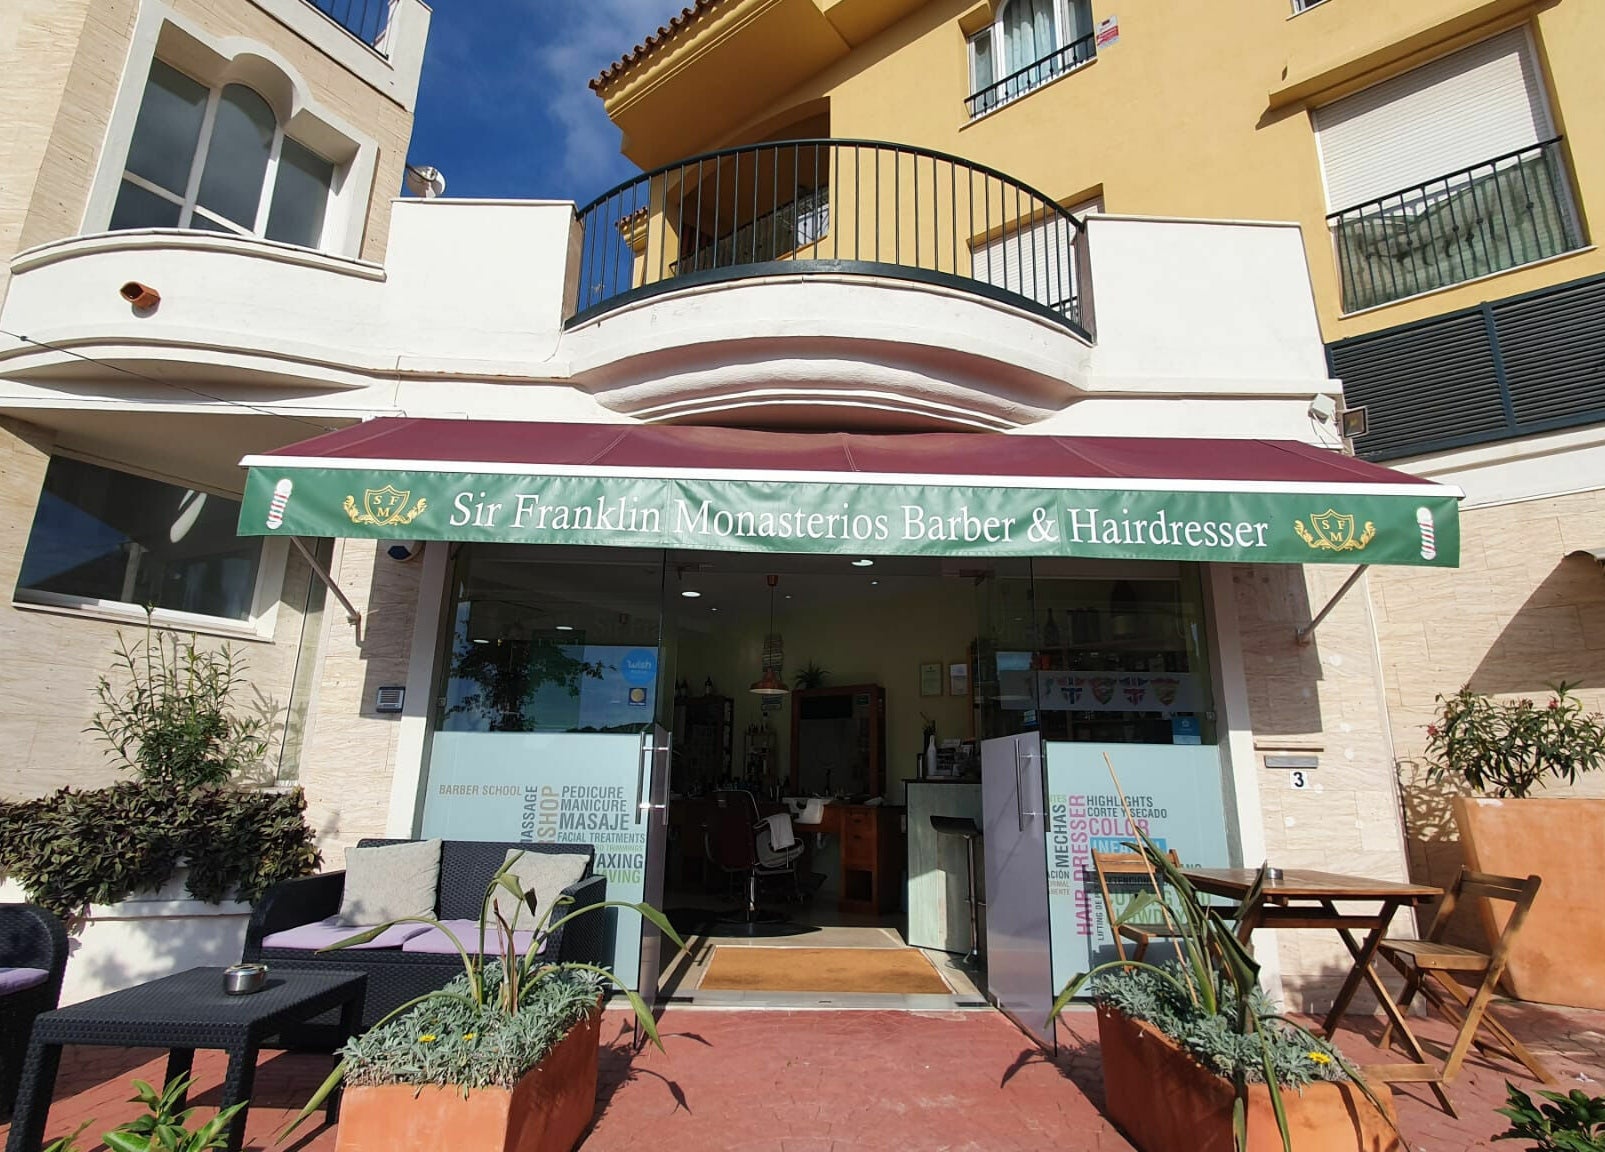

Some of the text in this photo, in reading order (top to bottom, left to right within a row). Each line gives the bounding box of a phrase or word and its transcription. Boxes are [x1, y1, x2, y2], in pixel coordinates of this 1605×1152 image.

[373, 495, 399, 506] S F
[376, 507, 390, 518] M
[449, 490, 1269, 548] Sir Franklin Monasterios Barber & Hairdresser
[1321, 519, 1346, 530] S F
[1329, 531, 1343, 542] M
[1293, 771, 1304, 788] 3
[438, 784, 522, 797] BARBER SCHOOL
[562, 786, 624, 799] PEDICURE
[560, 799, 627, 812] MANICURE
[537, 785, 559, 843] SHOP
[1087, 807, 1118, 817] CORTE
[1131, 808, 1167, 819] SECADO
[559, 813, 630, 830] MASAJE
[557, 832, 645, 843] FACIAL TREATMENTS
[1052, 804, 1069, 868] MECHAS
[1068, 795, 1094, 936] HAIR DRESSER
